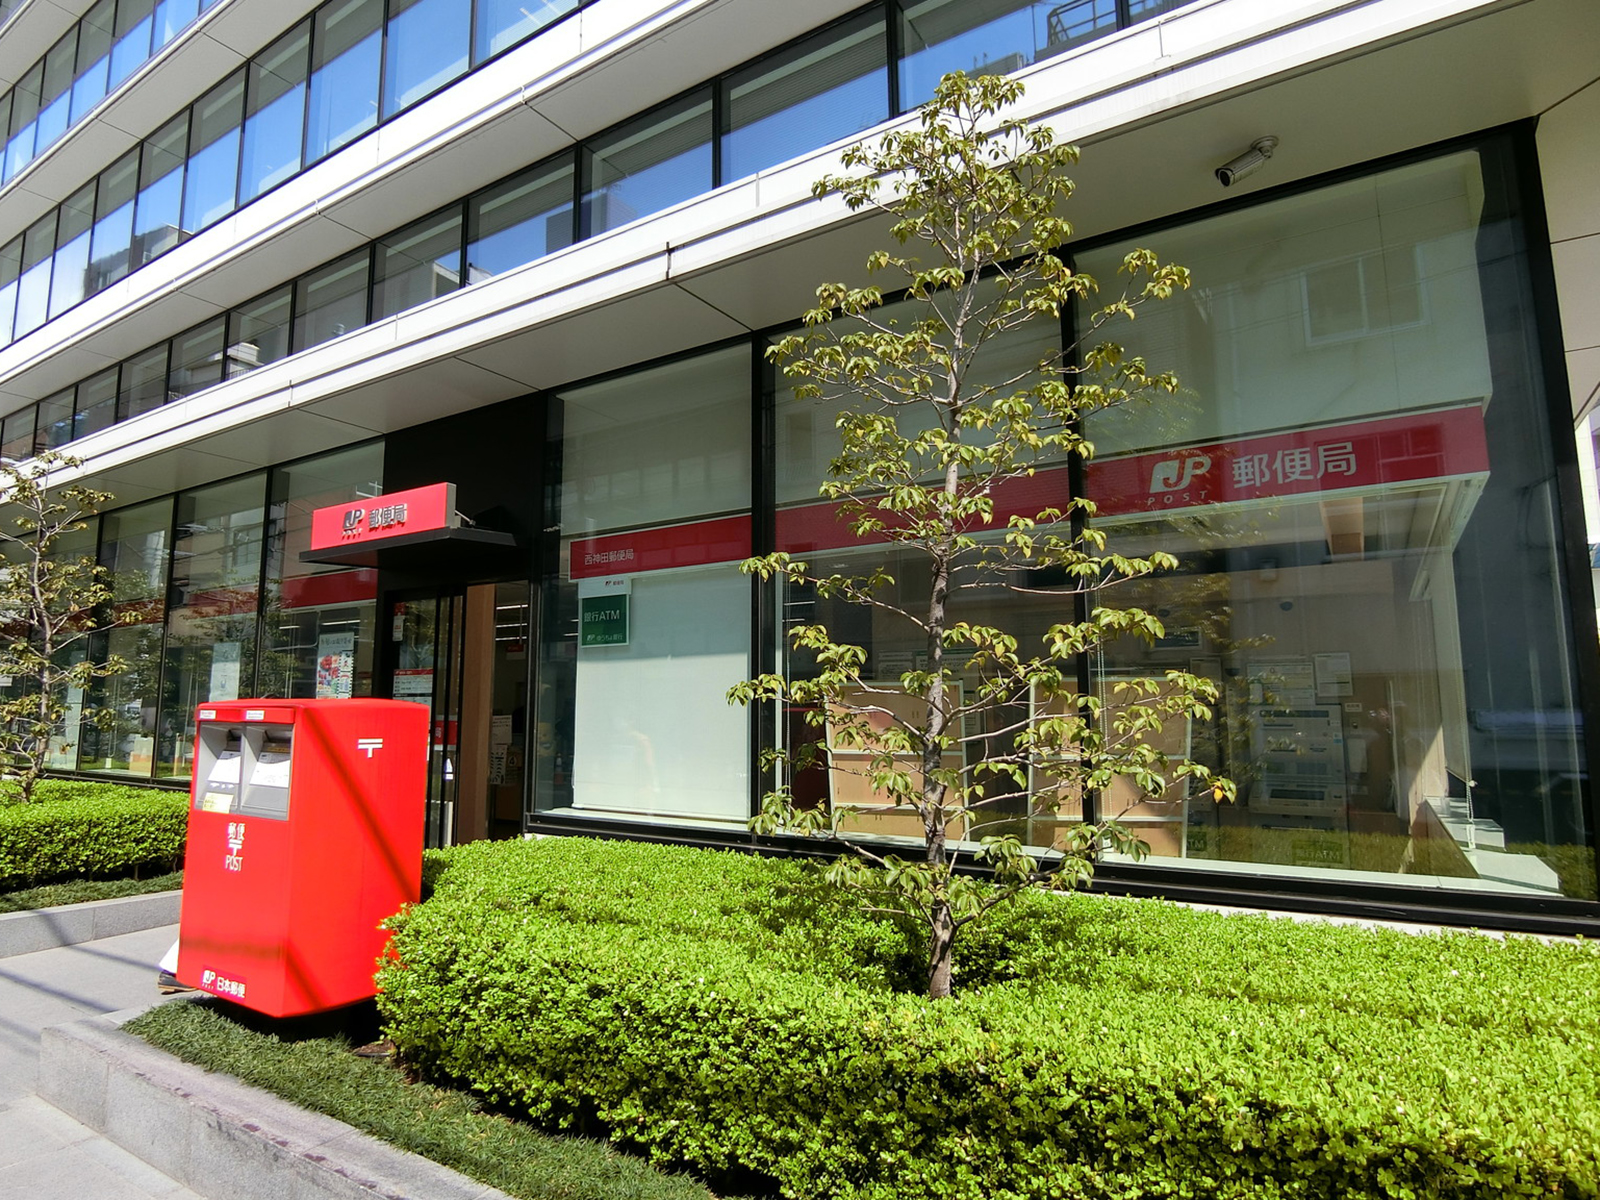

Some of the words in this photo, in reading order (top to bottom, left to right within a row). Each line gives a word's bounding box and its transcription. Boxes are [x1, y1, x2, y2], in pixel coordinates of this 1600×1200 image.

[1150, 456, 1212, 493] JP
[1232, 441, 1358, 489] 郵便局
[1147, 490, 1208, 506] POST
[343, 508, 365, 529] JP
[368, 503, 408, 528] 郵便局
[584, 548, 634, 565] 西神田郵便局
[583, 609, 620, 622] 銀行ATM
[227, 822, 246, 840] 郵便
[225, 854, 243, 872] POST
[217, 976, 246, 998] 日本郵便
